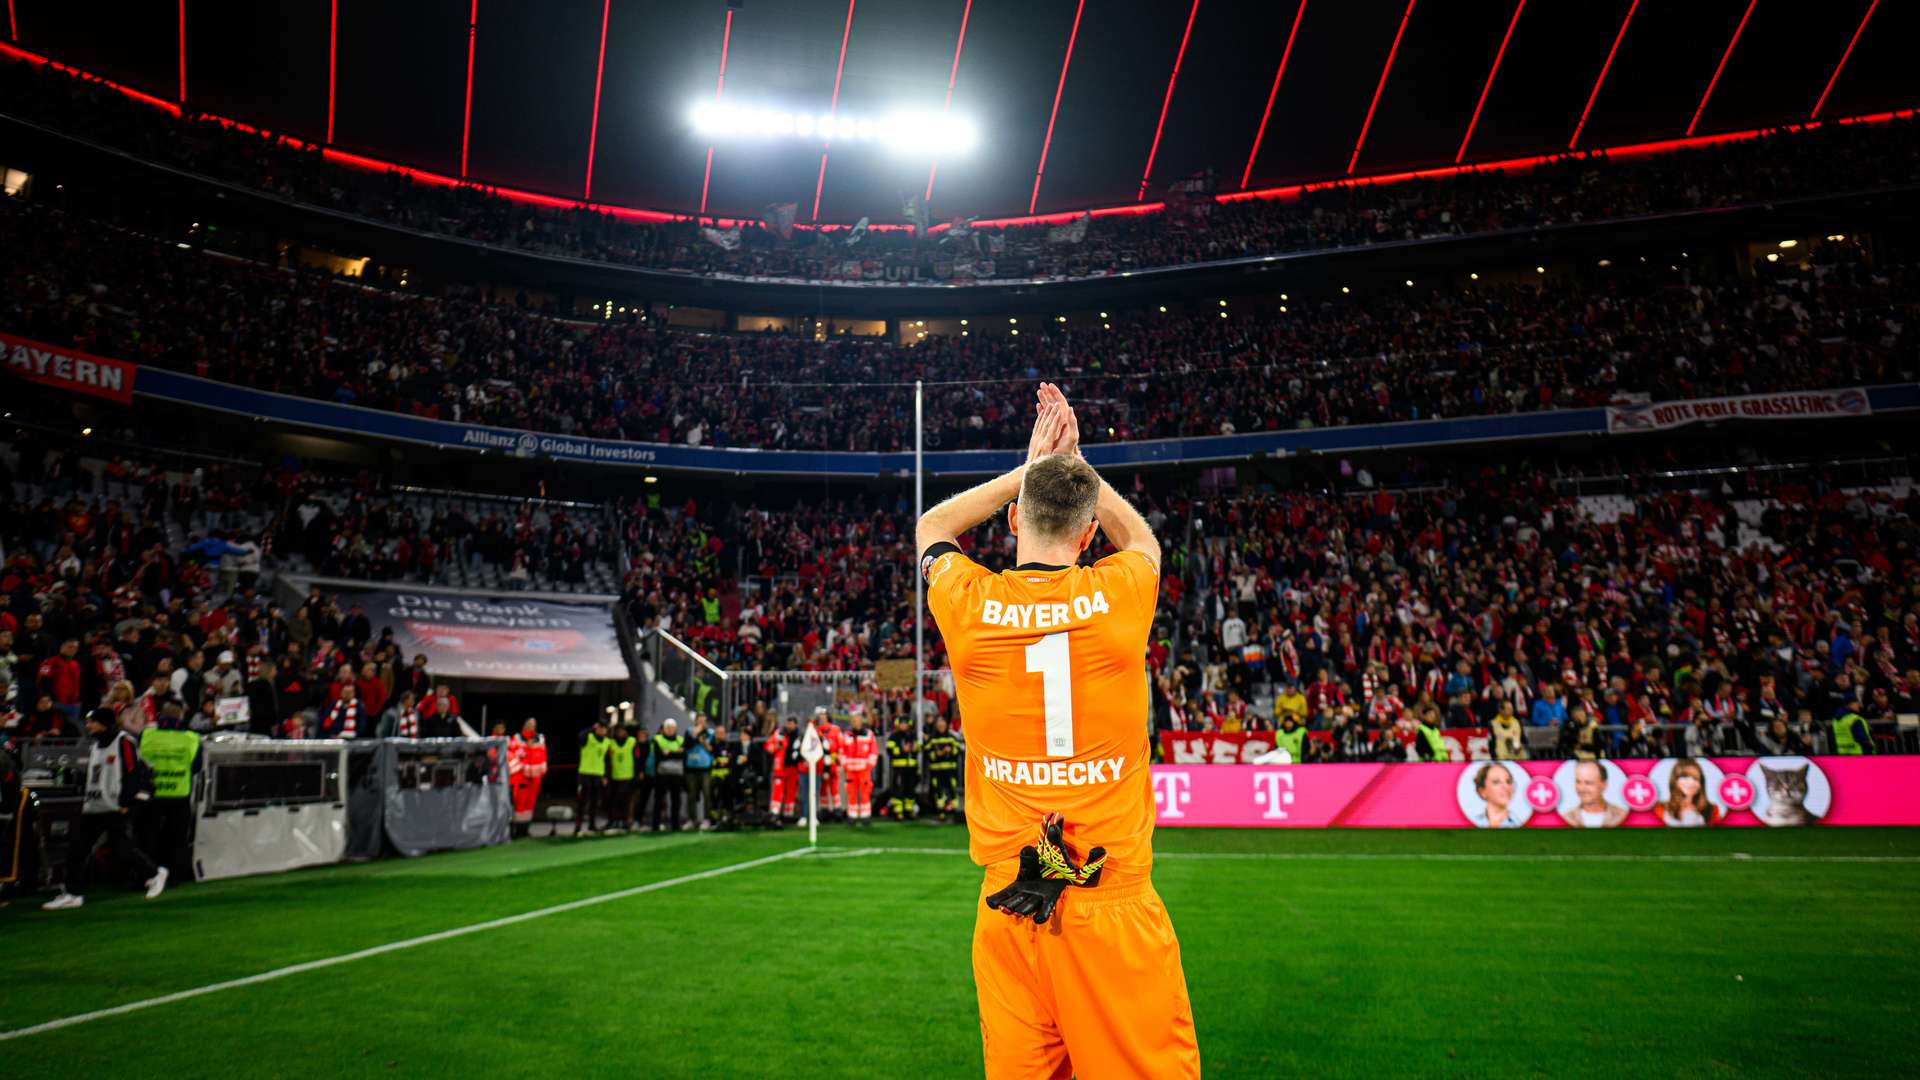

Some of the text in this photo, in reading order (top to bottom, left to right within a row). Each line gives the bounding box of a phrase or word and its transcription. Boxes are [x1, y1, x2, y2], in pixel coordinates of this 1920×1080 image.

[463, 429, 656, 461] Allianz Global Investors
[389, 606, 571, 628] der Bayern
[397, 594, 544, 617] Die Bank
[981, 591, 1110, 628] BAYER 04
[1025, 631, 1074, 757] 1
[983, 756, 1126, 786] HRADECKY
[1152, 772, 1295, 818] T T
